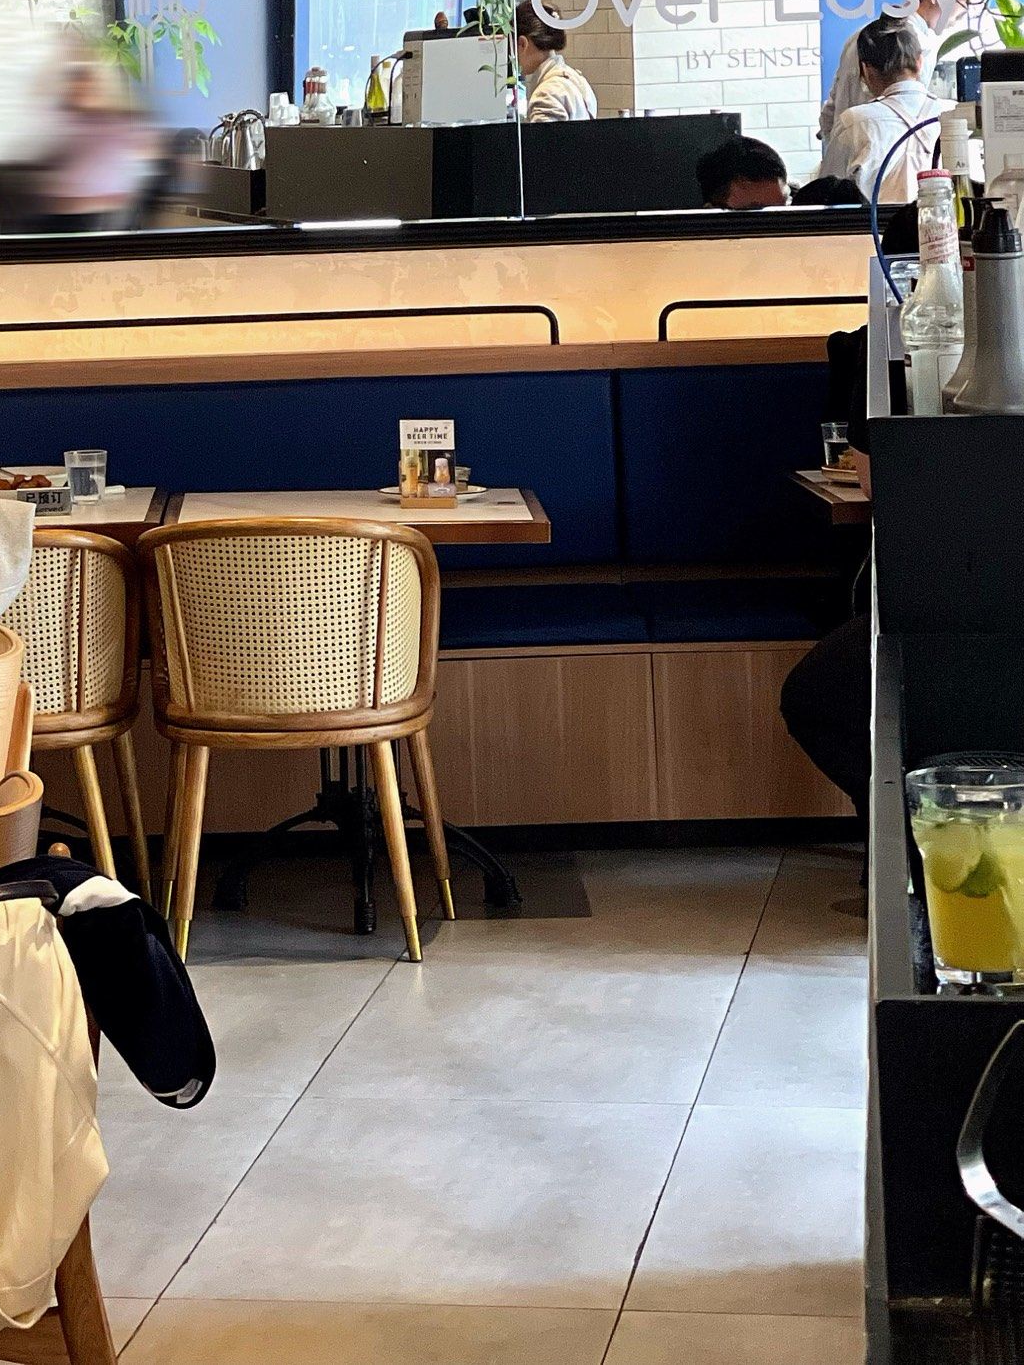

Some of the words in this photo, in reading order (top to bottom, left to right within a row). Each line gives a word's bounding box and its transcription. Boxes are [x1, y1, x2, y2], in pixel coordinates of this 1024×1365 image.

[685, 49, 716, 70] BY
[727, 46, 822, 68] SENSES
[26, 491, 63, 505] 已预订
